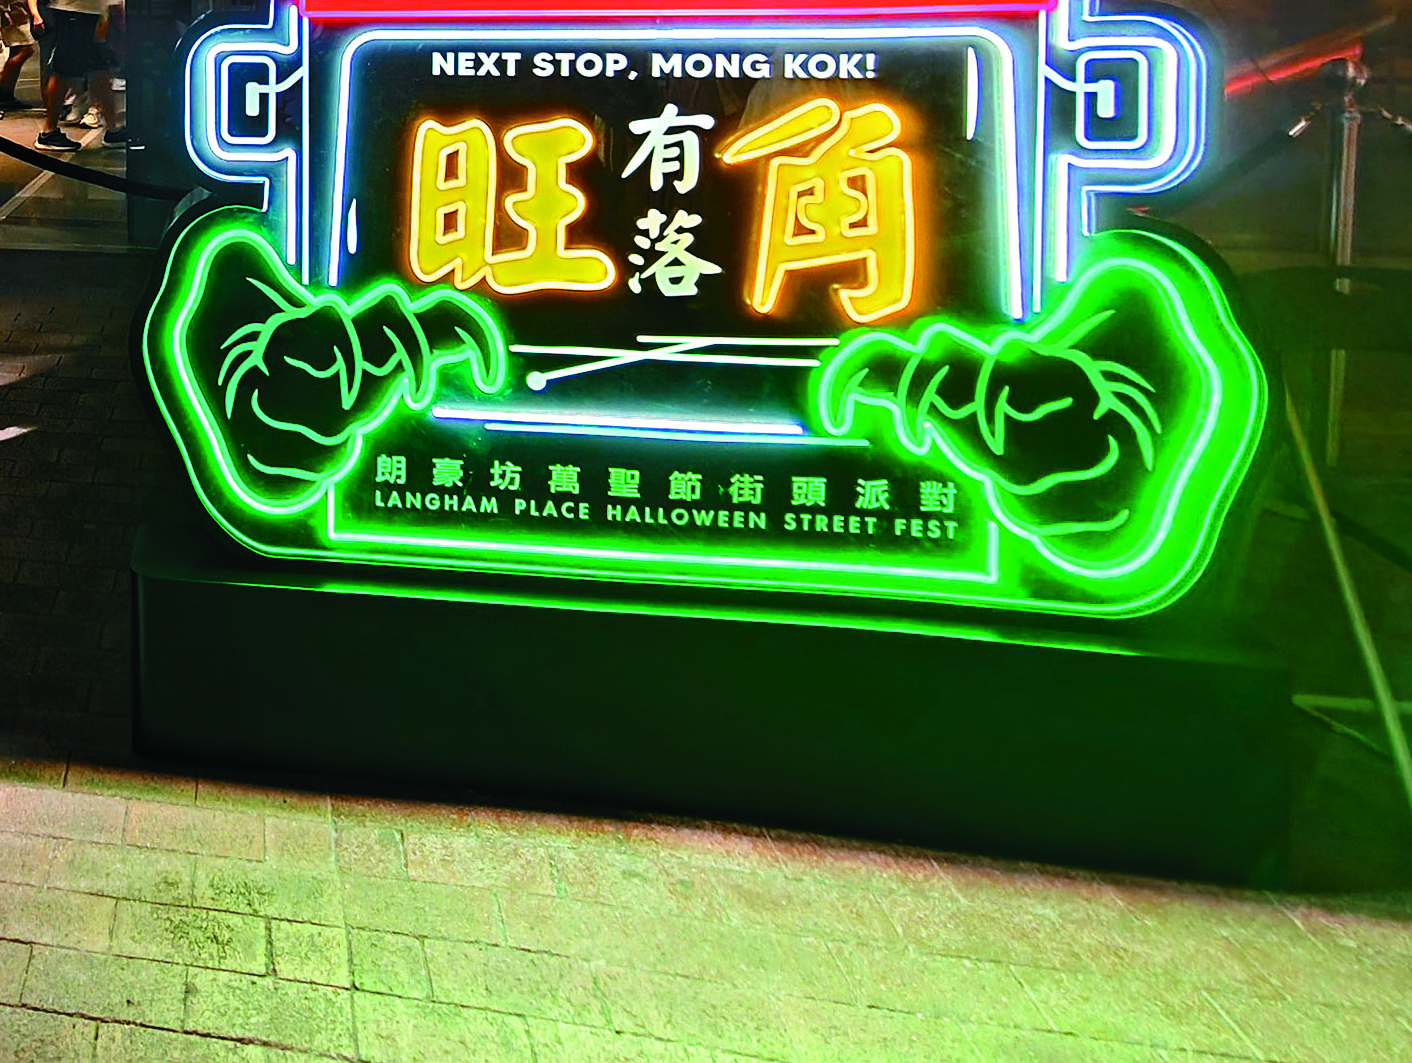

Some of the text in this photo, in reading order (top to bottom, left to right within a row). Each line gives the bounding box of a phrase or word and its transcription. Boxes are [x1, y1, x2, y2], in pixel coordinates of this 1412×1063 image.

[433, 52, 876, 81] NEXT STOP, MONG KOK!
[412, 119, 616, 294] 旺
[716, 97, 916, 324] 角
[374, 454, 958, 514] 朗豪坊萬聖節街頭派對
[374, 491, 959, 541] LANGHAM PLACE HALLOWEEN STREET FEST
